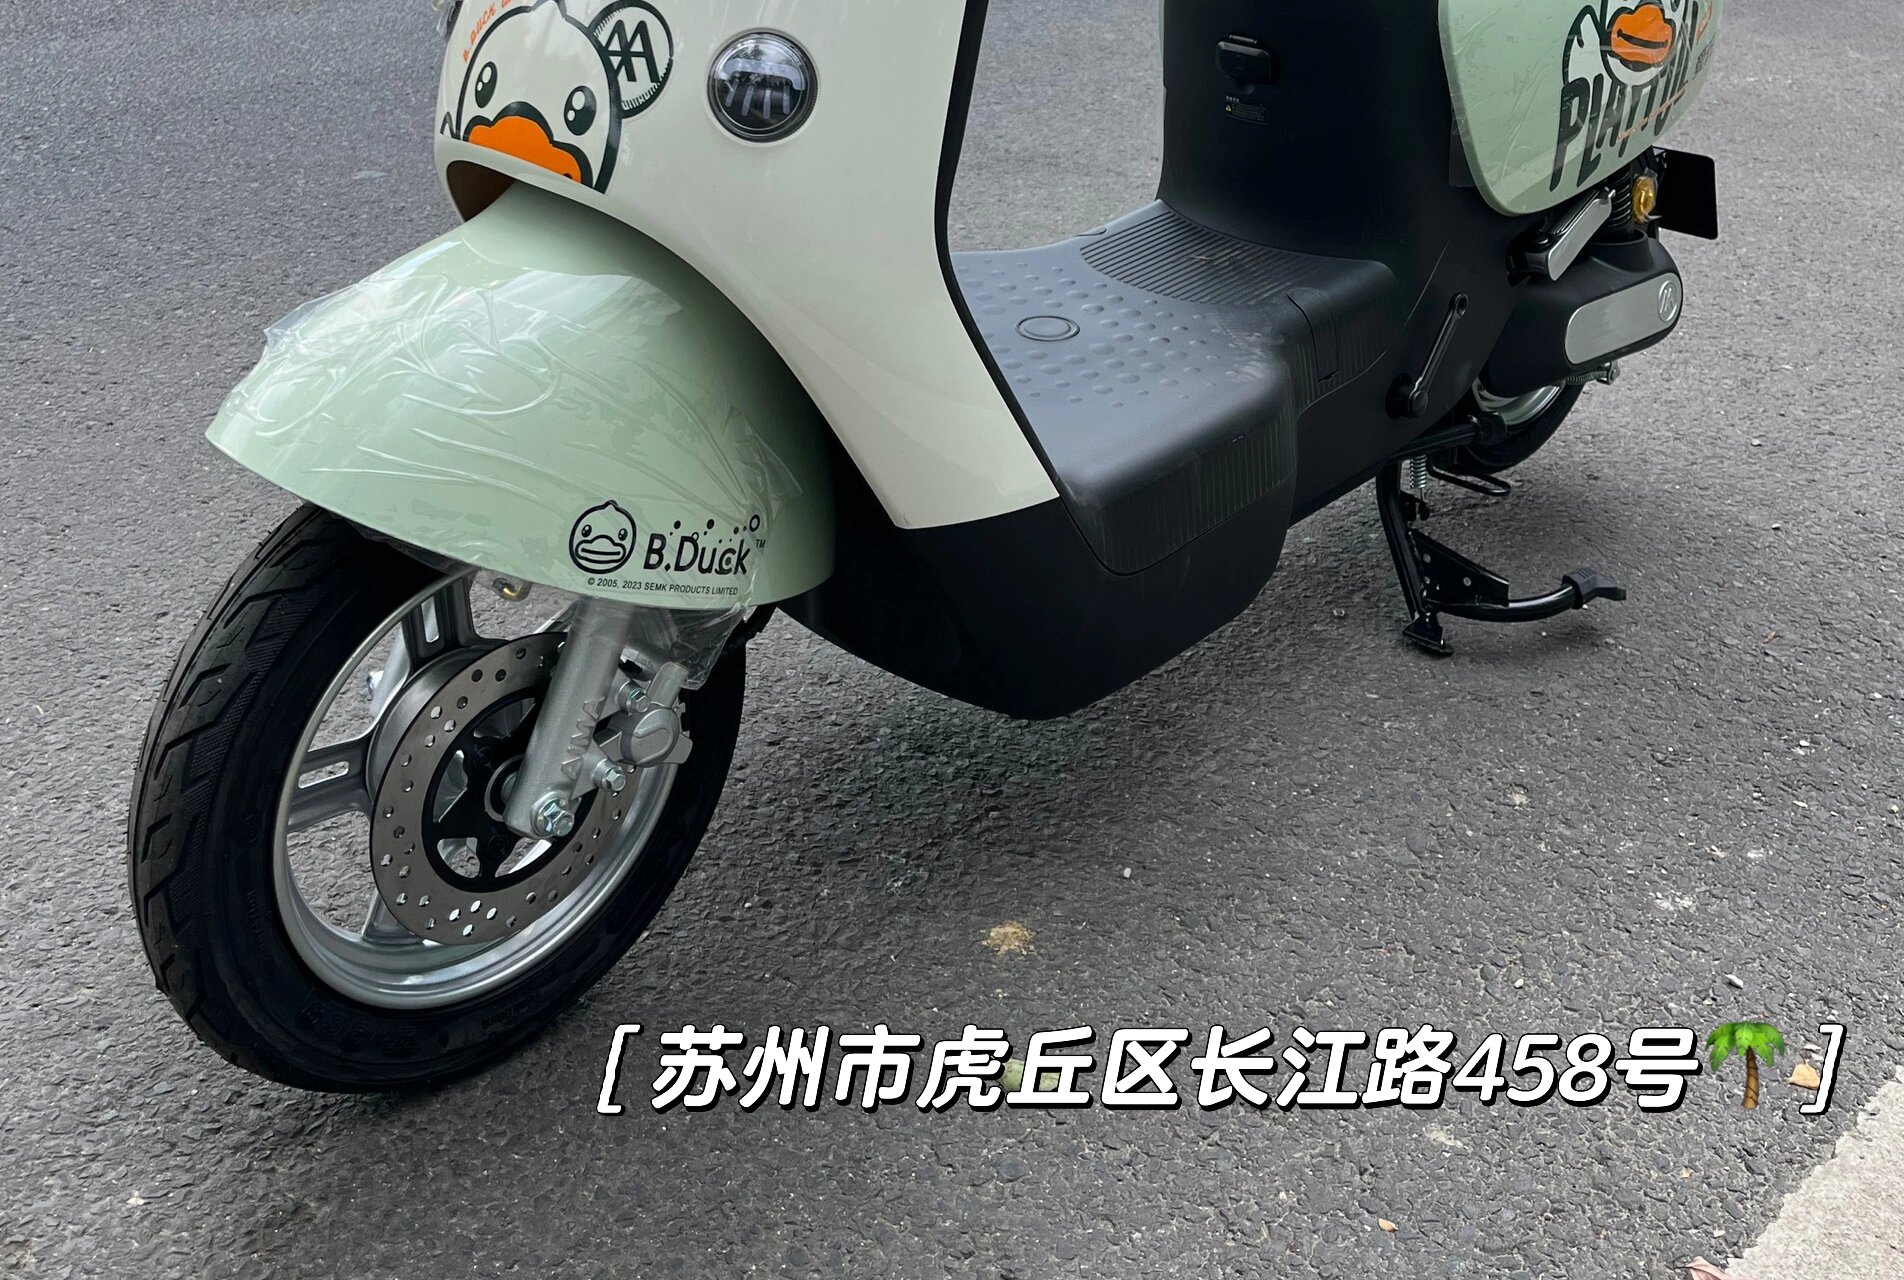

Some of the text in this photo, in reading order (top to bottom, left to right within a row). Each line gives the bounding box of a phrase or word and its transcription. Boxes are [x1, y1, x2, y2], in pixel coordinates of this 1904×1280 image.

[643, 533, 751, 576] B.Duck
[597, 578, 620, 589] 2005,
[622, 580, 642, 590] 2023
[643, 582, 667, 592] SEMK
[668, 584, 711, 595] PRODUCTS
[711, 587, 738, 596] LIMITED
